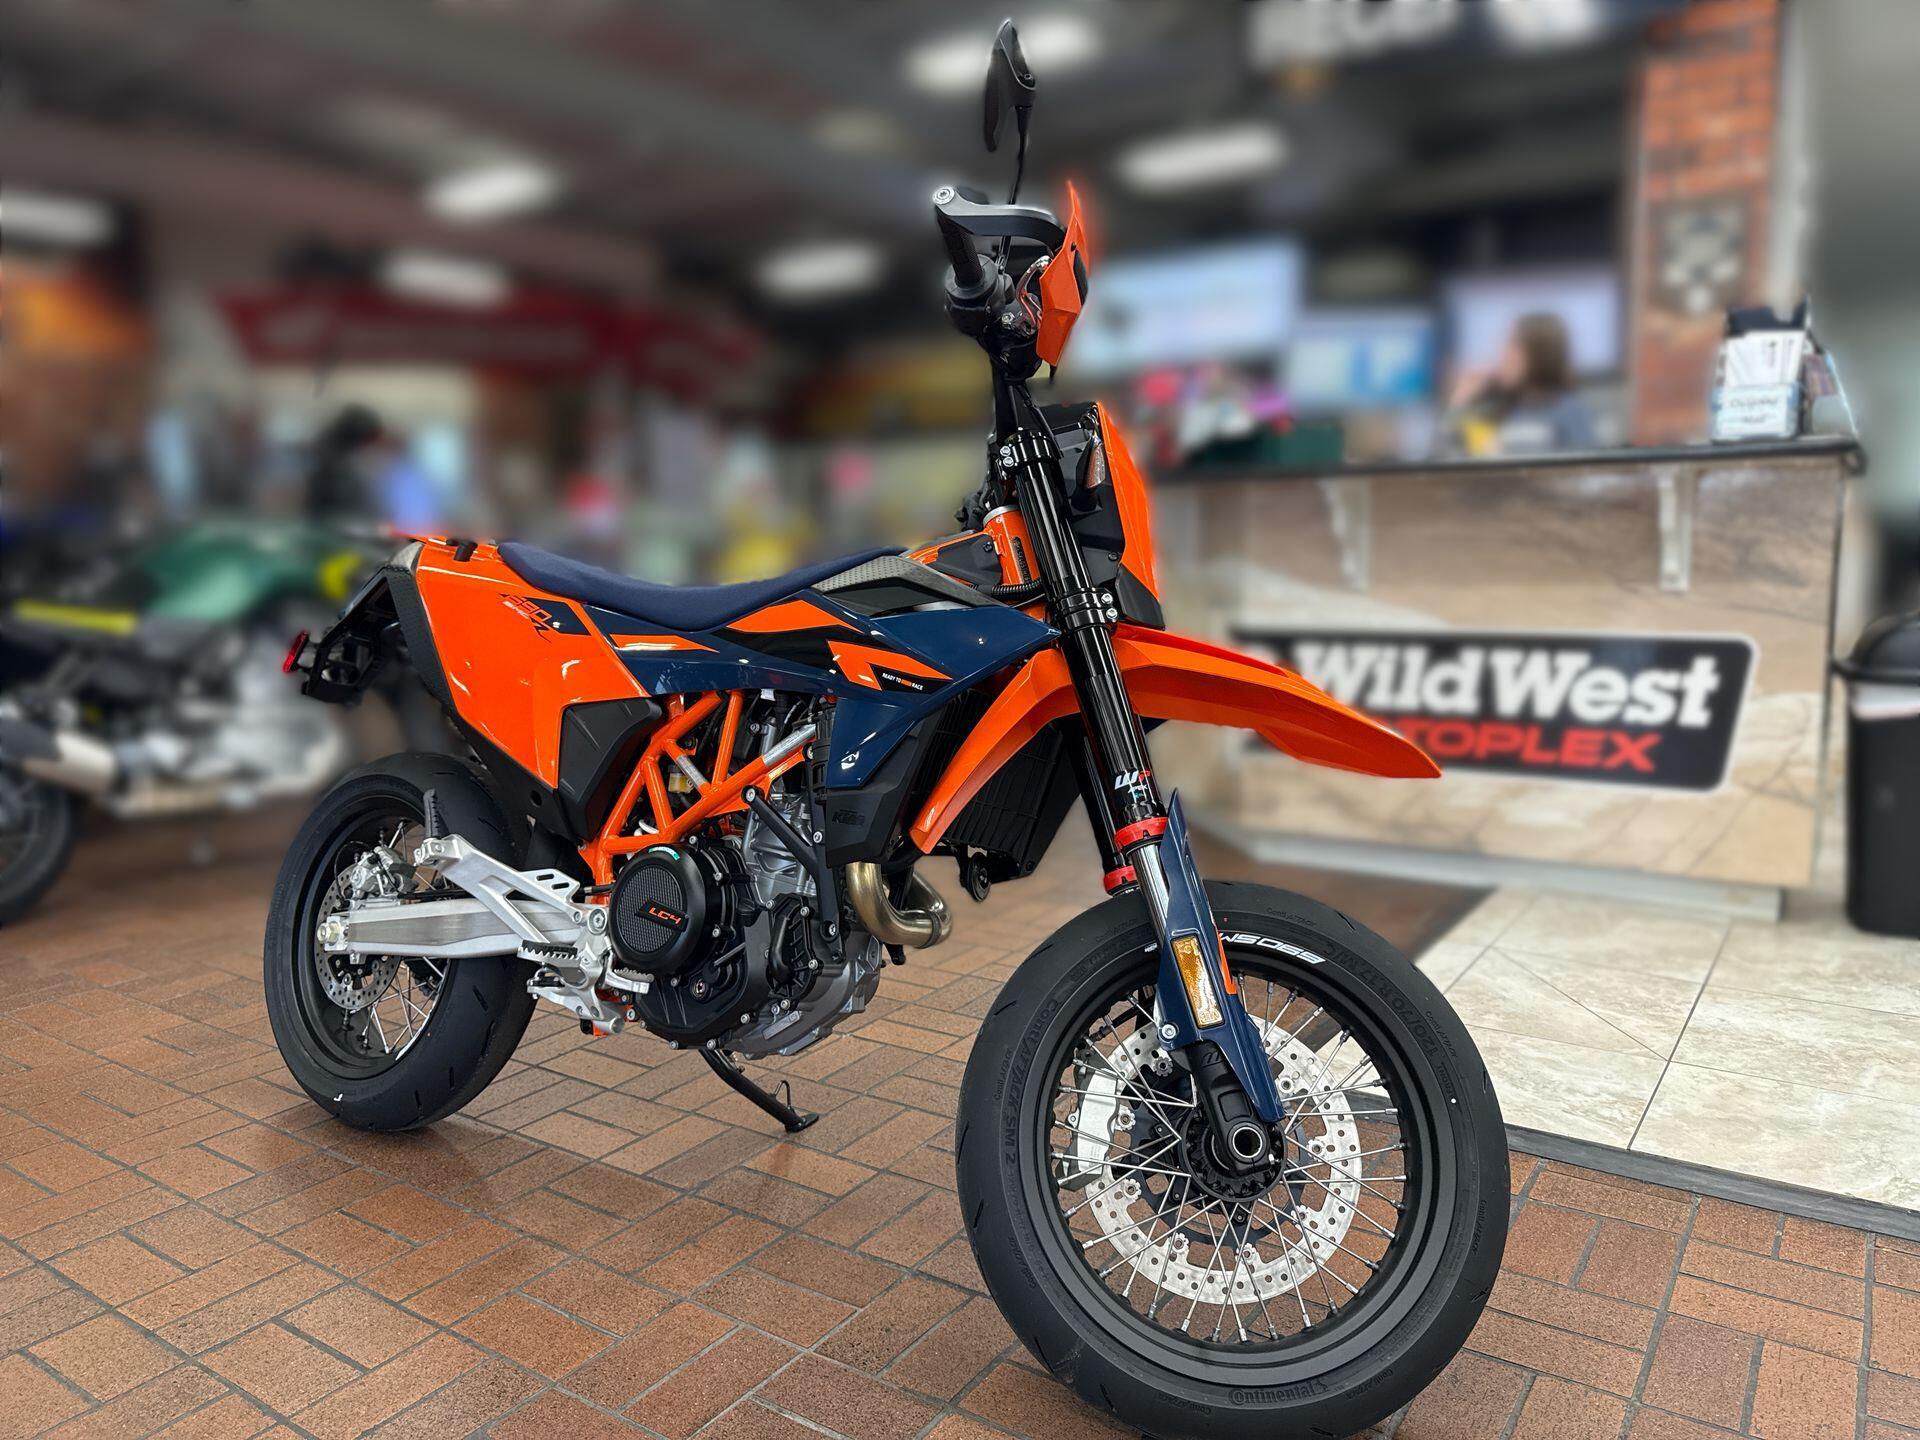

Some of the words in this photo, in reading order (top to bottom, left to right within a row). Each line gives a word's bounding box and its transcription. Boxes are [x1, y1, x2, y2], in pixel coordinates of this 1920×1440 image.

[1293, 642, 1486, 714] Wild
[1489, 646, 1722, 728] West
[1385, 716, 1662, 773] TOPLEX
[648, 907, 683, 925] LC4
[1220, 932, 1328, 964] 690SM
[1003, 1112, 1017, 1146] SM
[1004, 1151, 1017, 1165] 2
[1228, 1380, 1314, 1407] Continental
